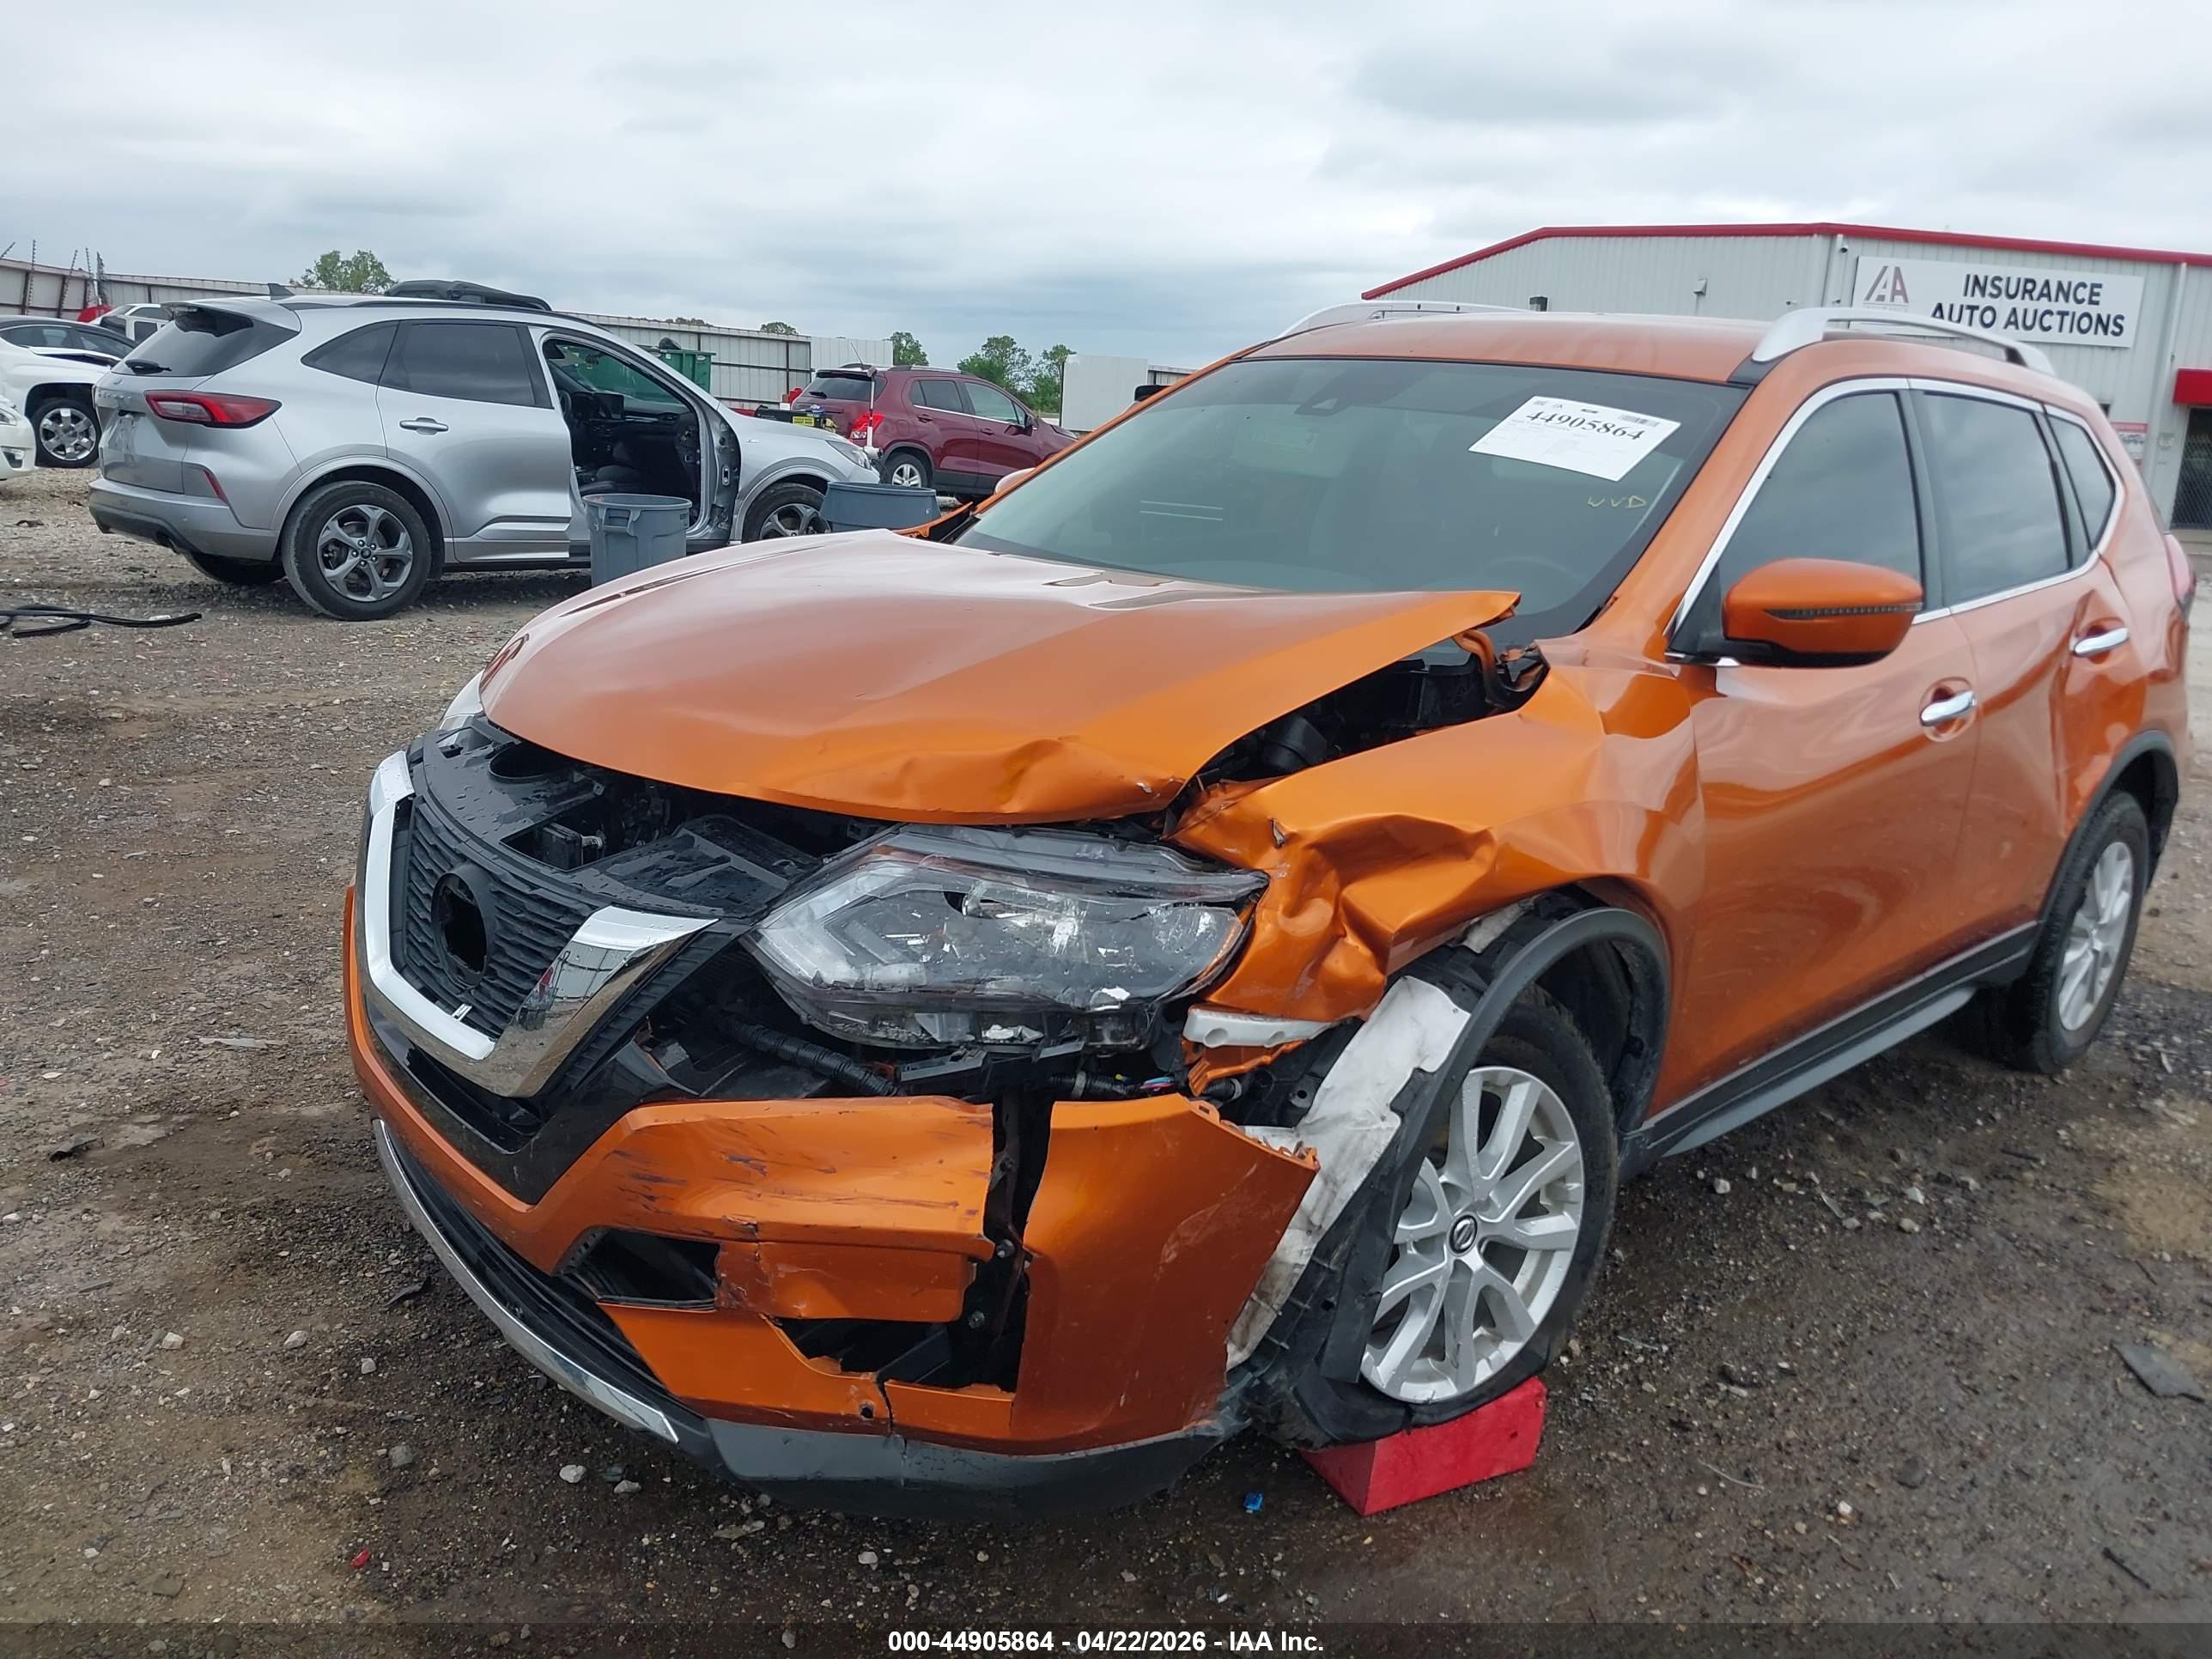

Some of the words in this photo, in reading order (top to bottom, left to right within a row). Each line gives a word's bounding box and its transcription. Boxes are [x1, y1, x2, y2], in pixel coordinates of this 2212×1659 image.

[1963, 273, 2103, 306] INSURANCE
[1930, 301, 1997, 330] AUTO
[2002, 307, 2125, 337] AUCTIONS
[1525, 410, 1646, 441] 44905864
